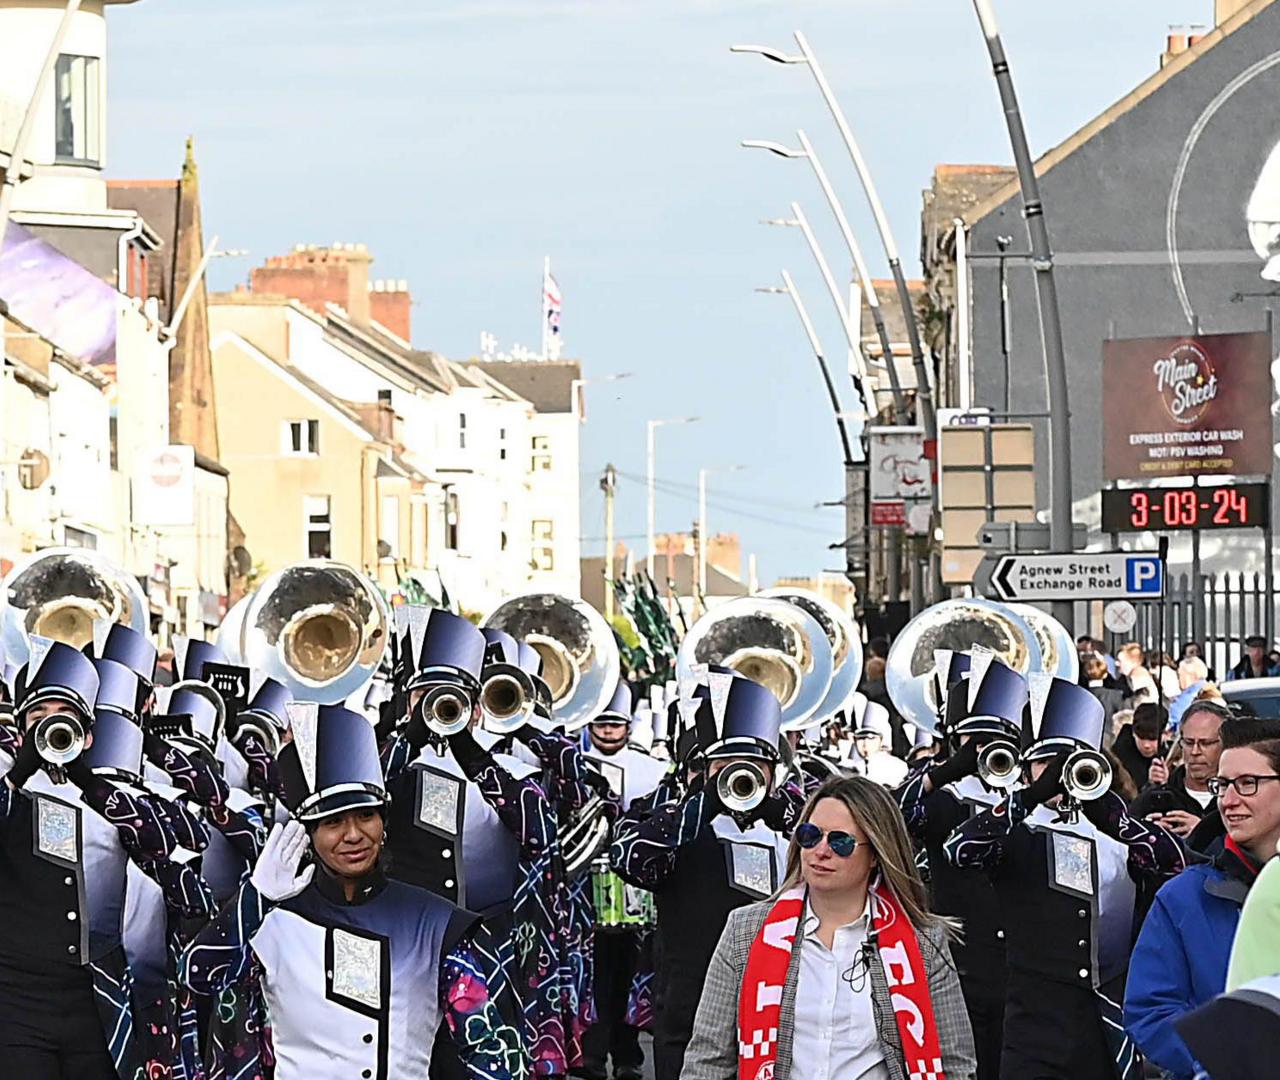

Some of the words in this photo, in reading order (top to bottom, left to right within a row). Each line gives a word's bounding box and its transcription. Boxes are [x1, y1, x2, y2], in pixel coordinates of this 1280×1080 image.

[1152, 357, 1198, 393] Main
[1171, 374, 1217, 414] Street
[1129, 433, 1163, 445] EXPRESS
[1164, 431, 1202, 443] EXTERIOR
[1202, 431, 1219, 441] CAR
[1220, 429, 1244, 440] WASH
[1130, 489, 1247, 527] 3-03-24
[1019, 564, 1063, 577] Agnew
[1069, 564, 1111, 575] Street
[1020, 577, 1083, 591] Exchange
[1088, 577, 1121, 588] Road
